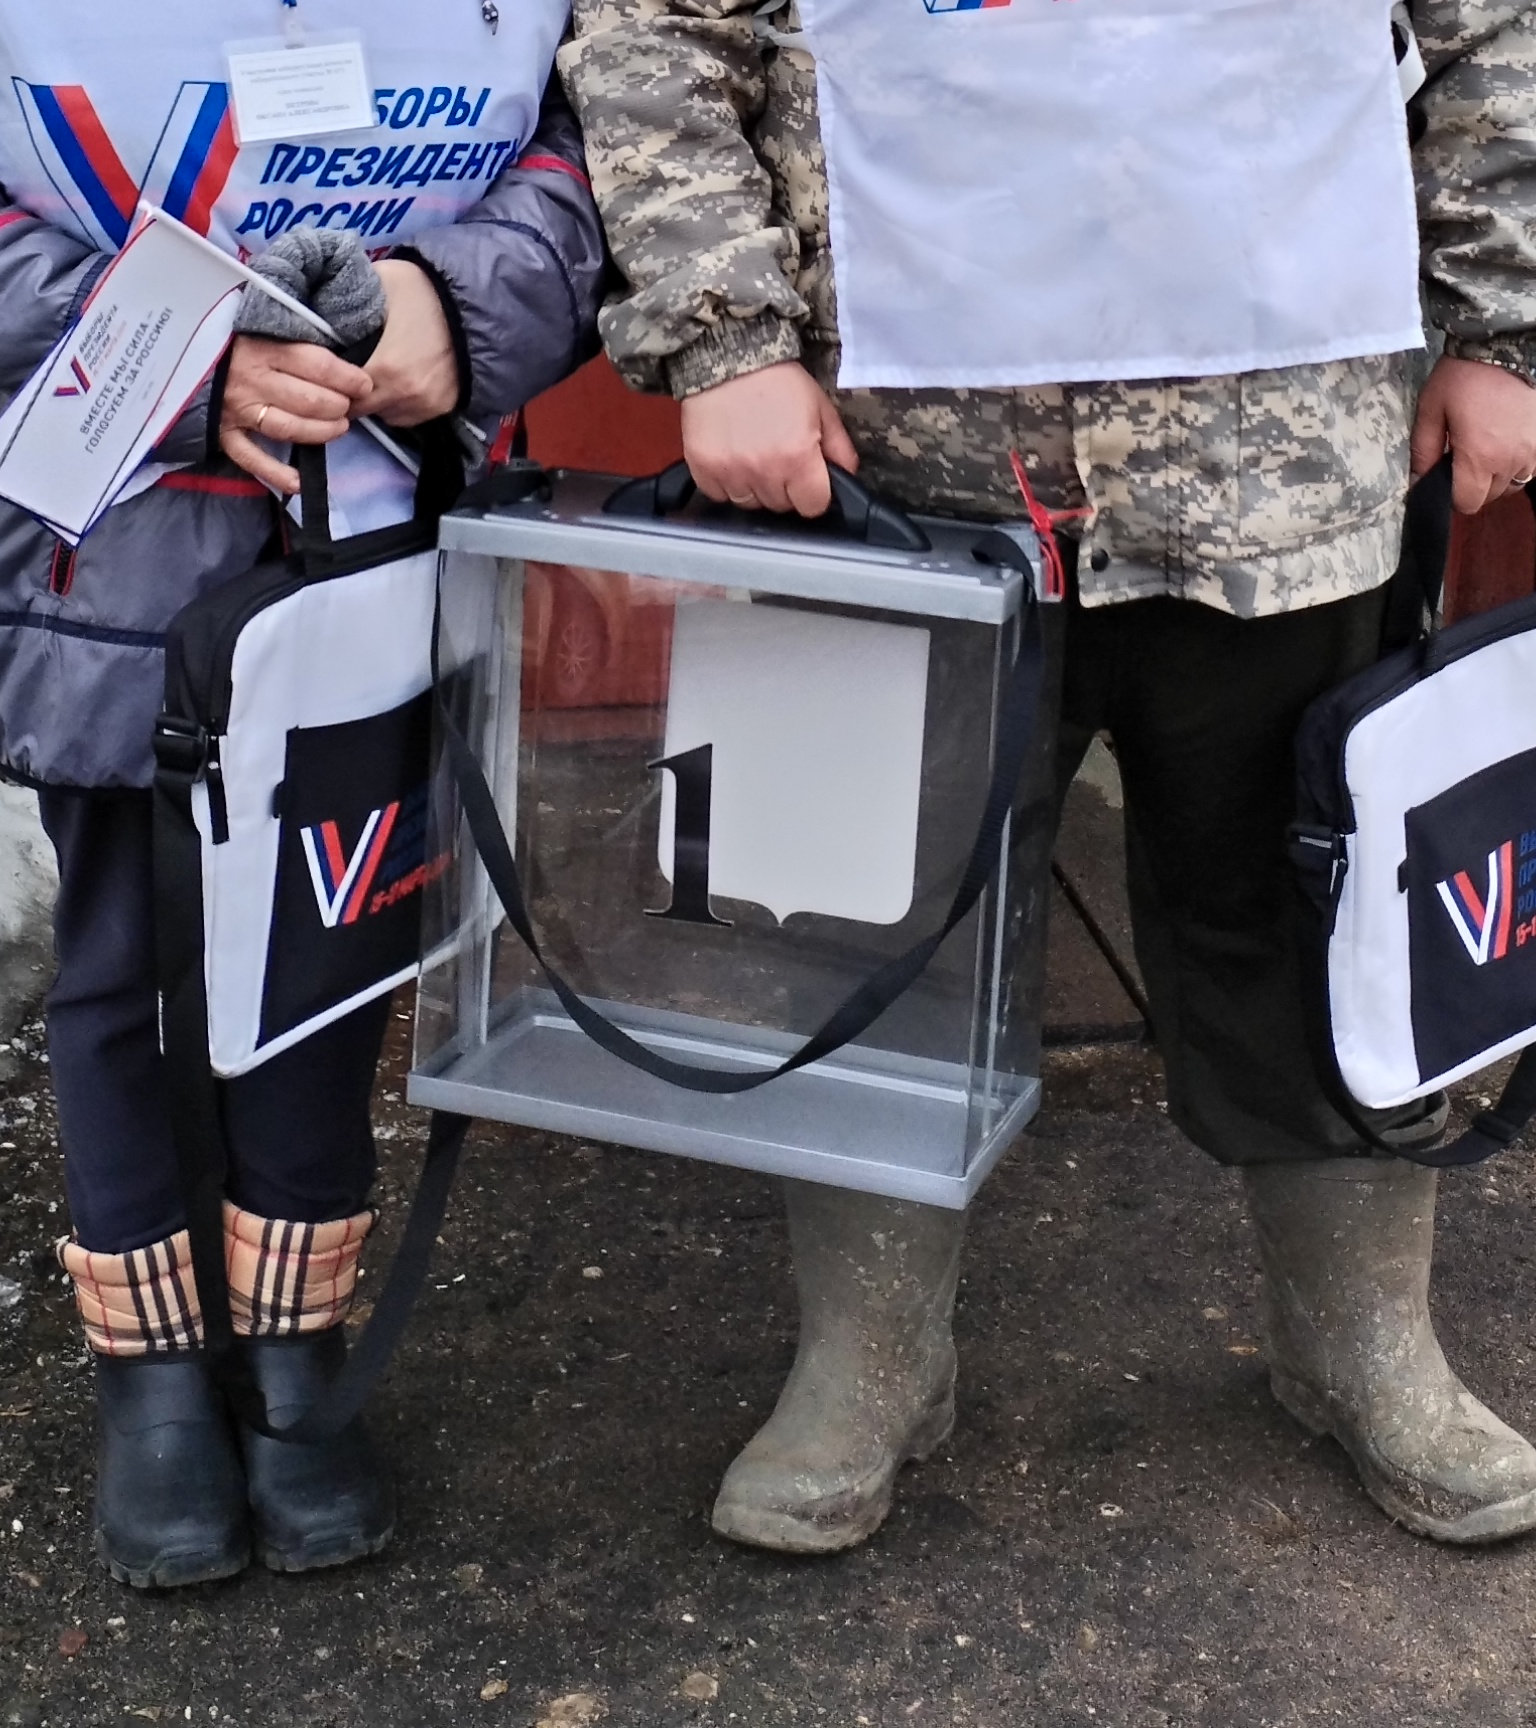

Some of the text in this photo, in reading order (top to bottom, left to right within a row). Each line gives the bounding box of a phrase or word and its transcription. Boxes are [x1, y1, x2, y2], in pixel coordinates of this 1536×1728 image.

[373, 86, 492, 130] БОРЫ
[79, 382, 114, 435] ВМЕСТЕ
[109, 359, 129, 384] МЫ
[125, 321, 150, 358] СИЛА
[84, 387, 129, 455] ГОЛОСУЕМ
[124, 368, 141, 386] ЗА
[135, 307, 174, 368] РОССИЮ!
